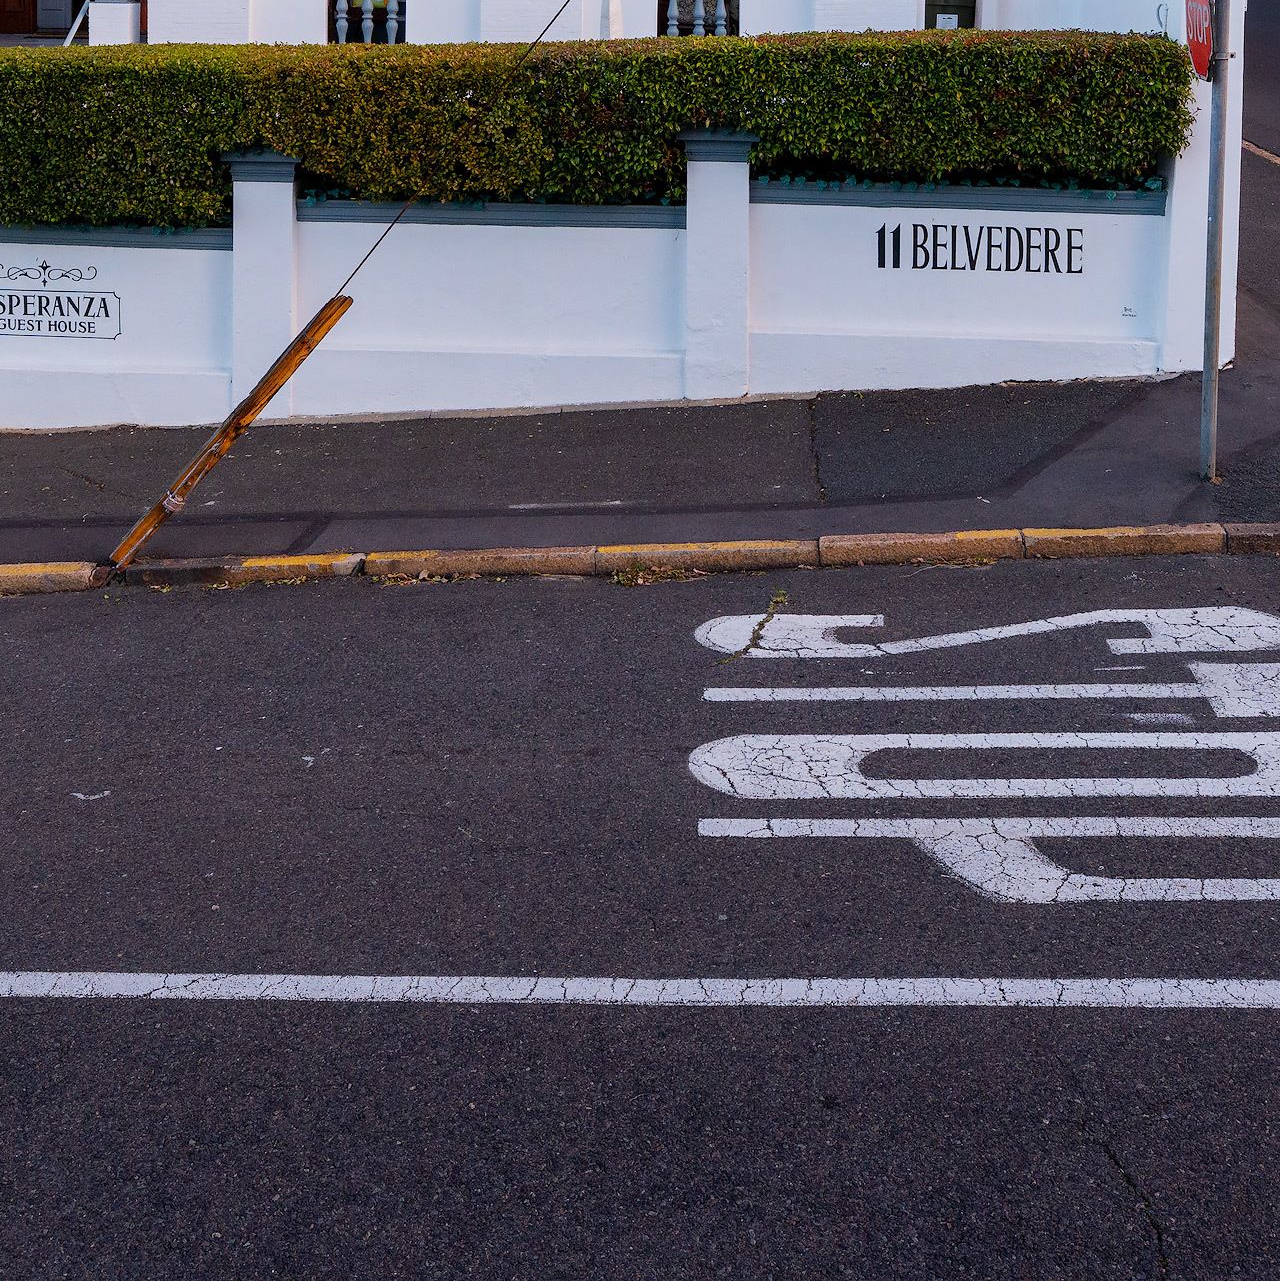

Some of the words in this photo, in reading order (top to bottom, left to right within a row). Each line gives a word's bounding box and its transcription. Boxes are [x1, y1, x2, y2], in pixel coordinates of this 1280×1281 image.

[1187, 0, 1210, 46] STOP
[875, 222, 901, 268] 11
[912, 223, 1084, 274] BELVEDERE
[48, 320, 96, 333] HOUSE
